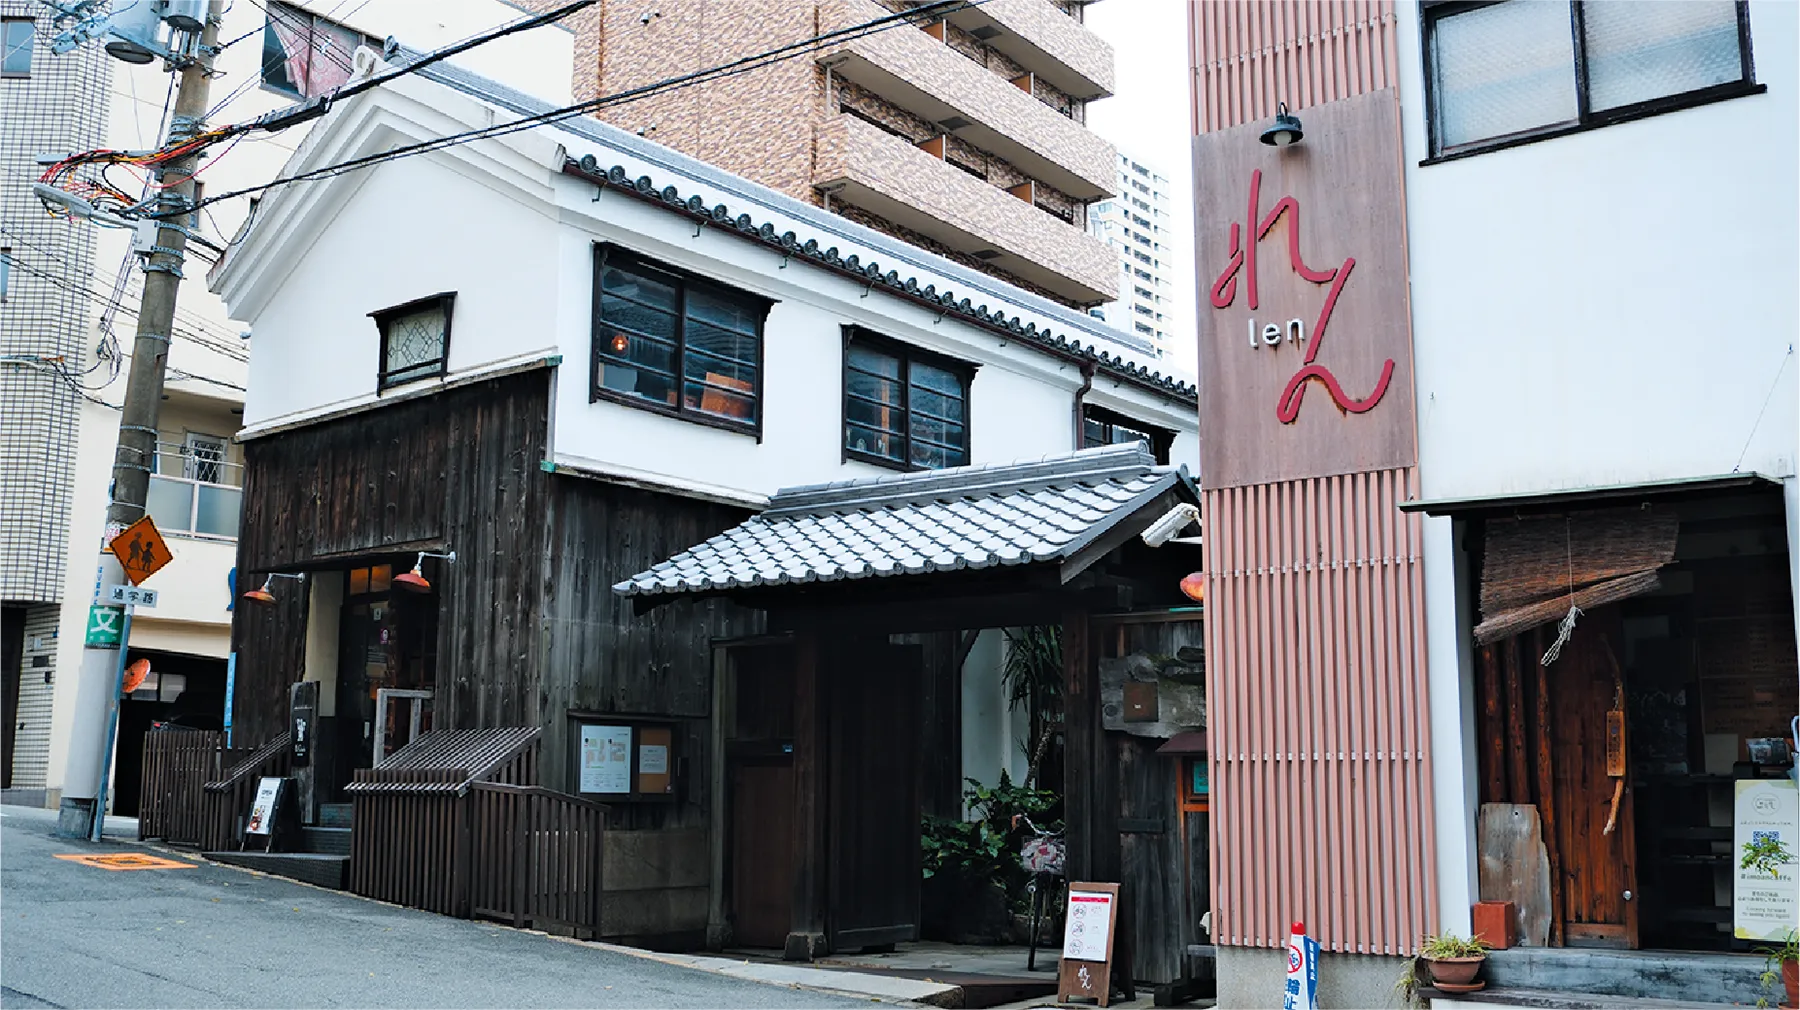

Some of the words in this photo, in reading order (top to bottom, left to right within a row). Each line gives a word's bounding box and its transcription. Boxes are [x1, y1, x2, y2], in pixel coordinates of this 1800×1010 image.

[1248, 317, 1305, 349] len
[112, 588, 154, 604] 通学路
[90, 606, 120, 634] 文
